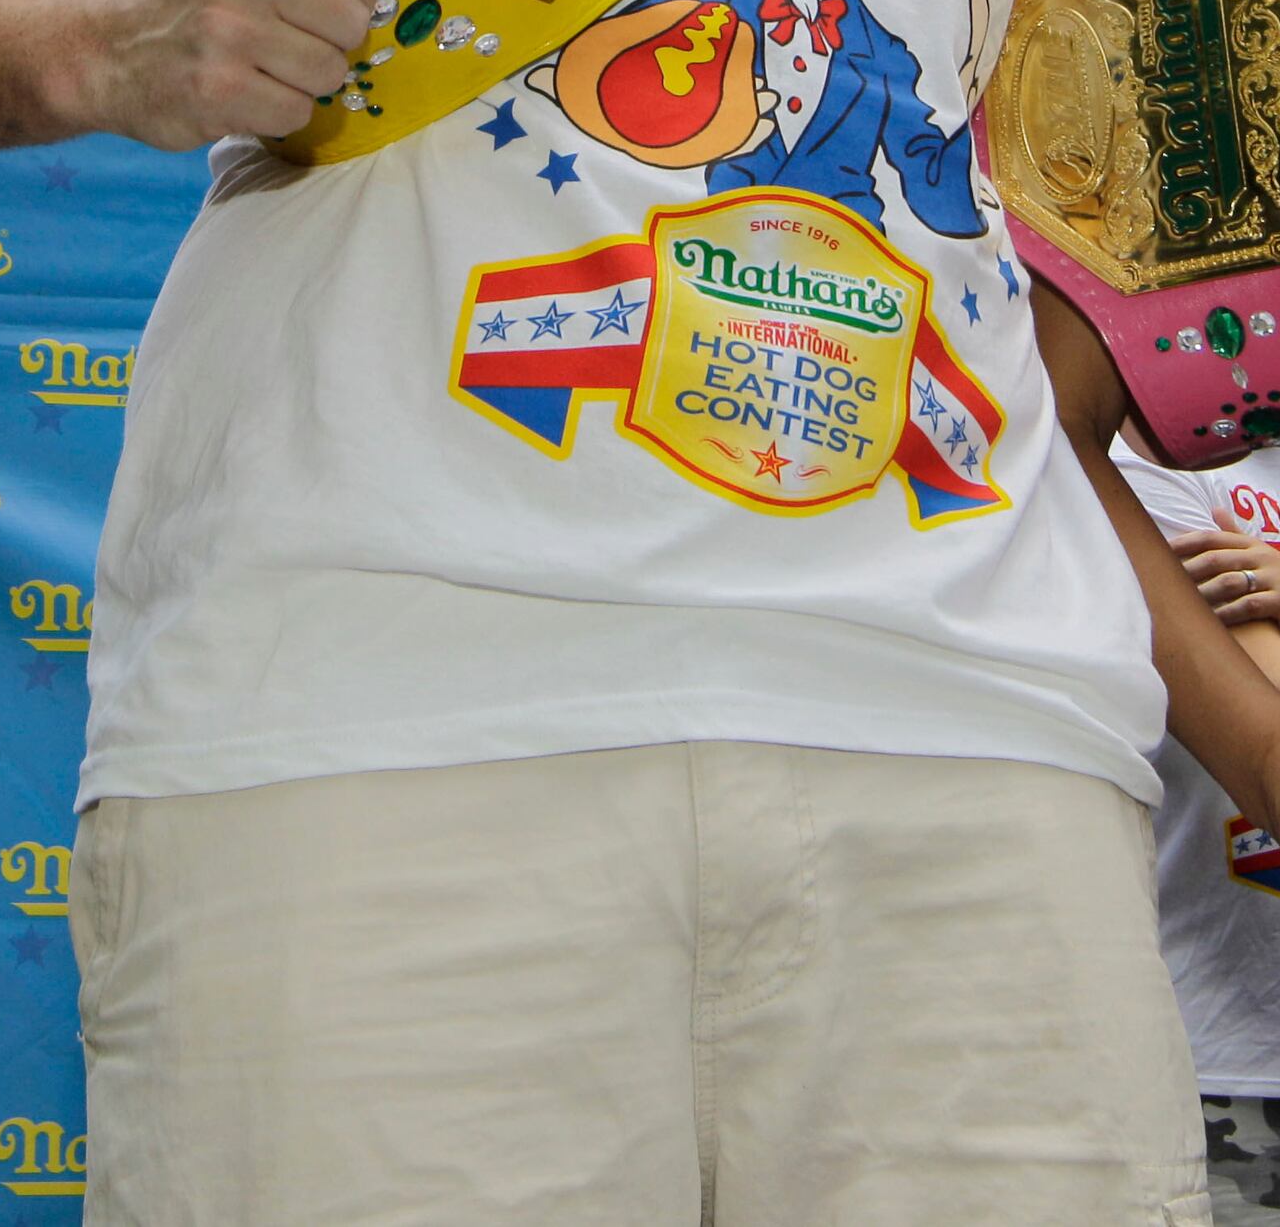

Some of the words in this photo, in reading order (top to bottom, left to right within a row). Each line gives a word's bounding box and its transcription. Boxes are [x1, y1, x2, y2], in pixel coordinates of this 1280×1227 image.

[750, 220, 802, 234] SINCE
[807, 226, 840, 251] 1916
[673, 239, 899, 320] Nathan's
[690, 331, 783, 371] HOT
[794, 356, 877, 401] DOG
[728, 321, 852, 364] INTERNATIONAL
[675, 391, 874, 459] CONTEST
[704, 363, 859, 425] EATING
